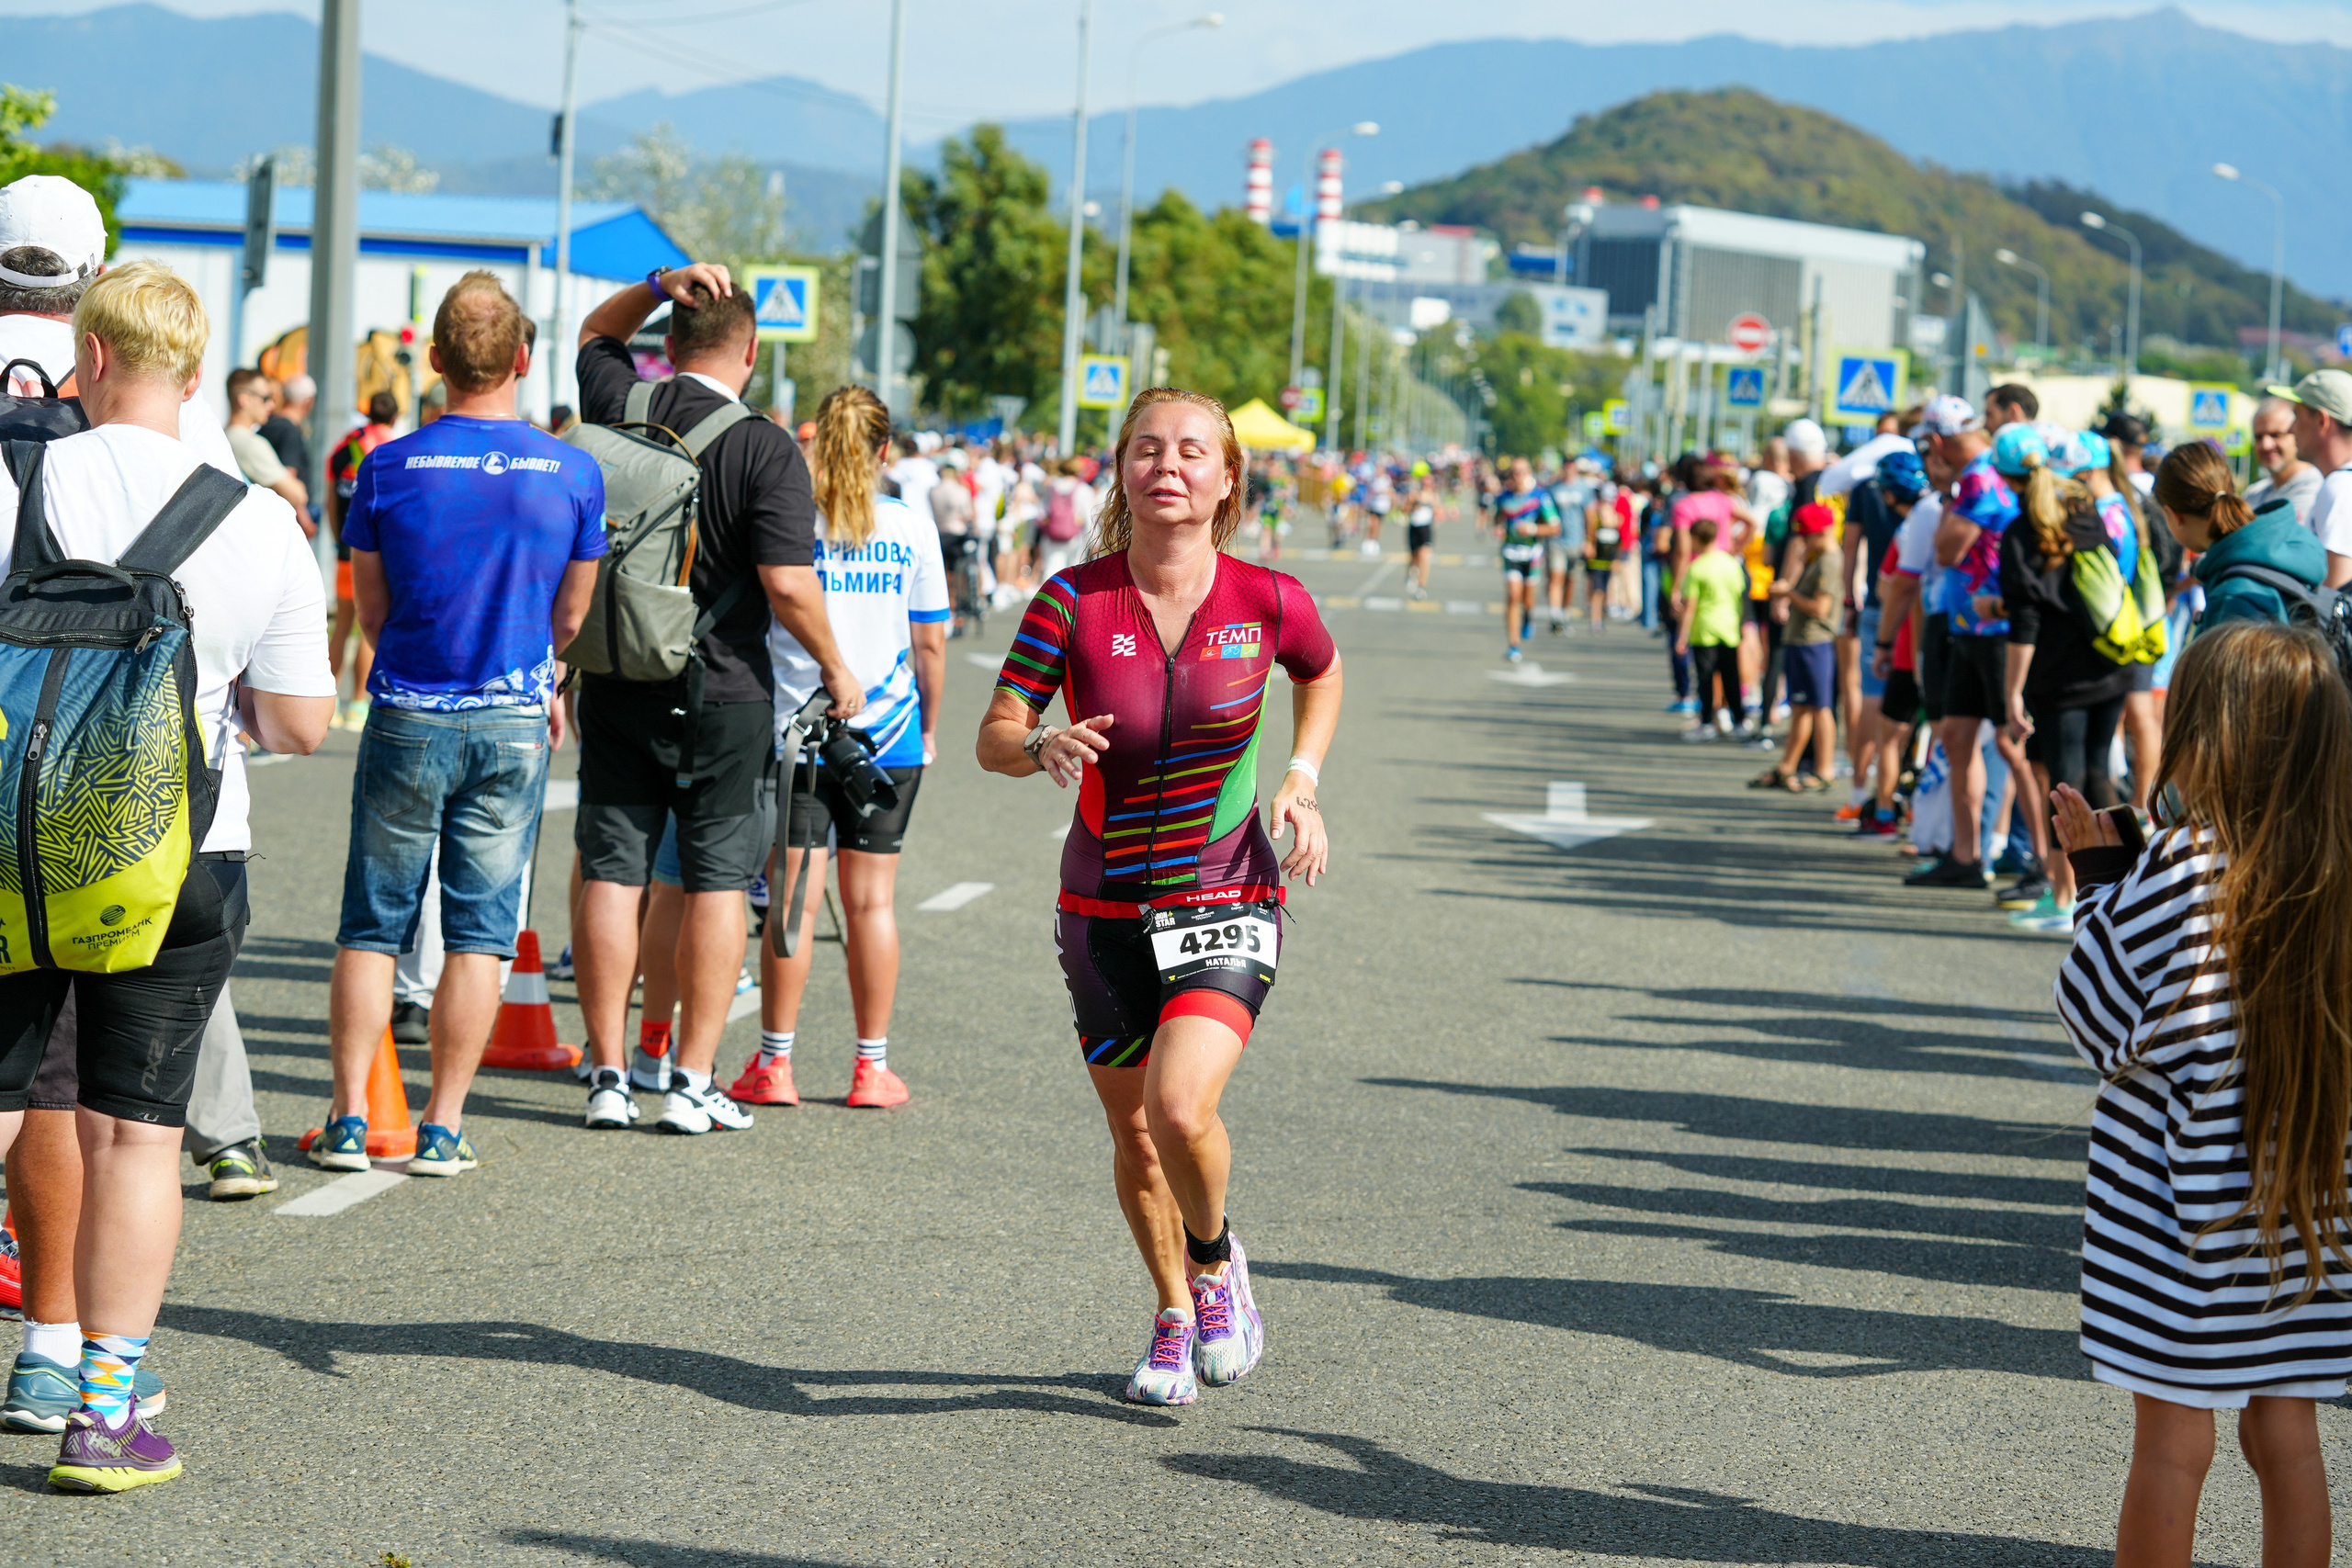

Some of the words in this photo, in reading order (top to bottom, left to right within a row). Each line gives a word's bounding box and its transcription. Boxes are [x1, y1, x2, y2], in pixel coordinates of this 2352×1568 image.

[404, 455, 482, 469] НЕБЫВАЕМОЕ
[509, 457, 561, 473] БЫВАЕТ!
[1206, 626, 1261, 647] ТЕМП
[1186, 889, 1241, 902] HEAD
[72, 917, 153, 945] ГАЗПРОМБАНК
[1155, 918, 1176, 928] STAR
[87, 929, 141, 950] ПРЕМИУМ
[1180, 924, 1261, 955] 4295
[1205, 957, 1247, 968] НАТАЛЬЯ
[141, 1036, 165, 1096] 2XU
[87, 1430, 122, 1459] HOKA
